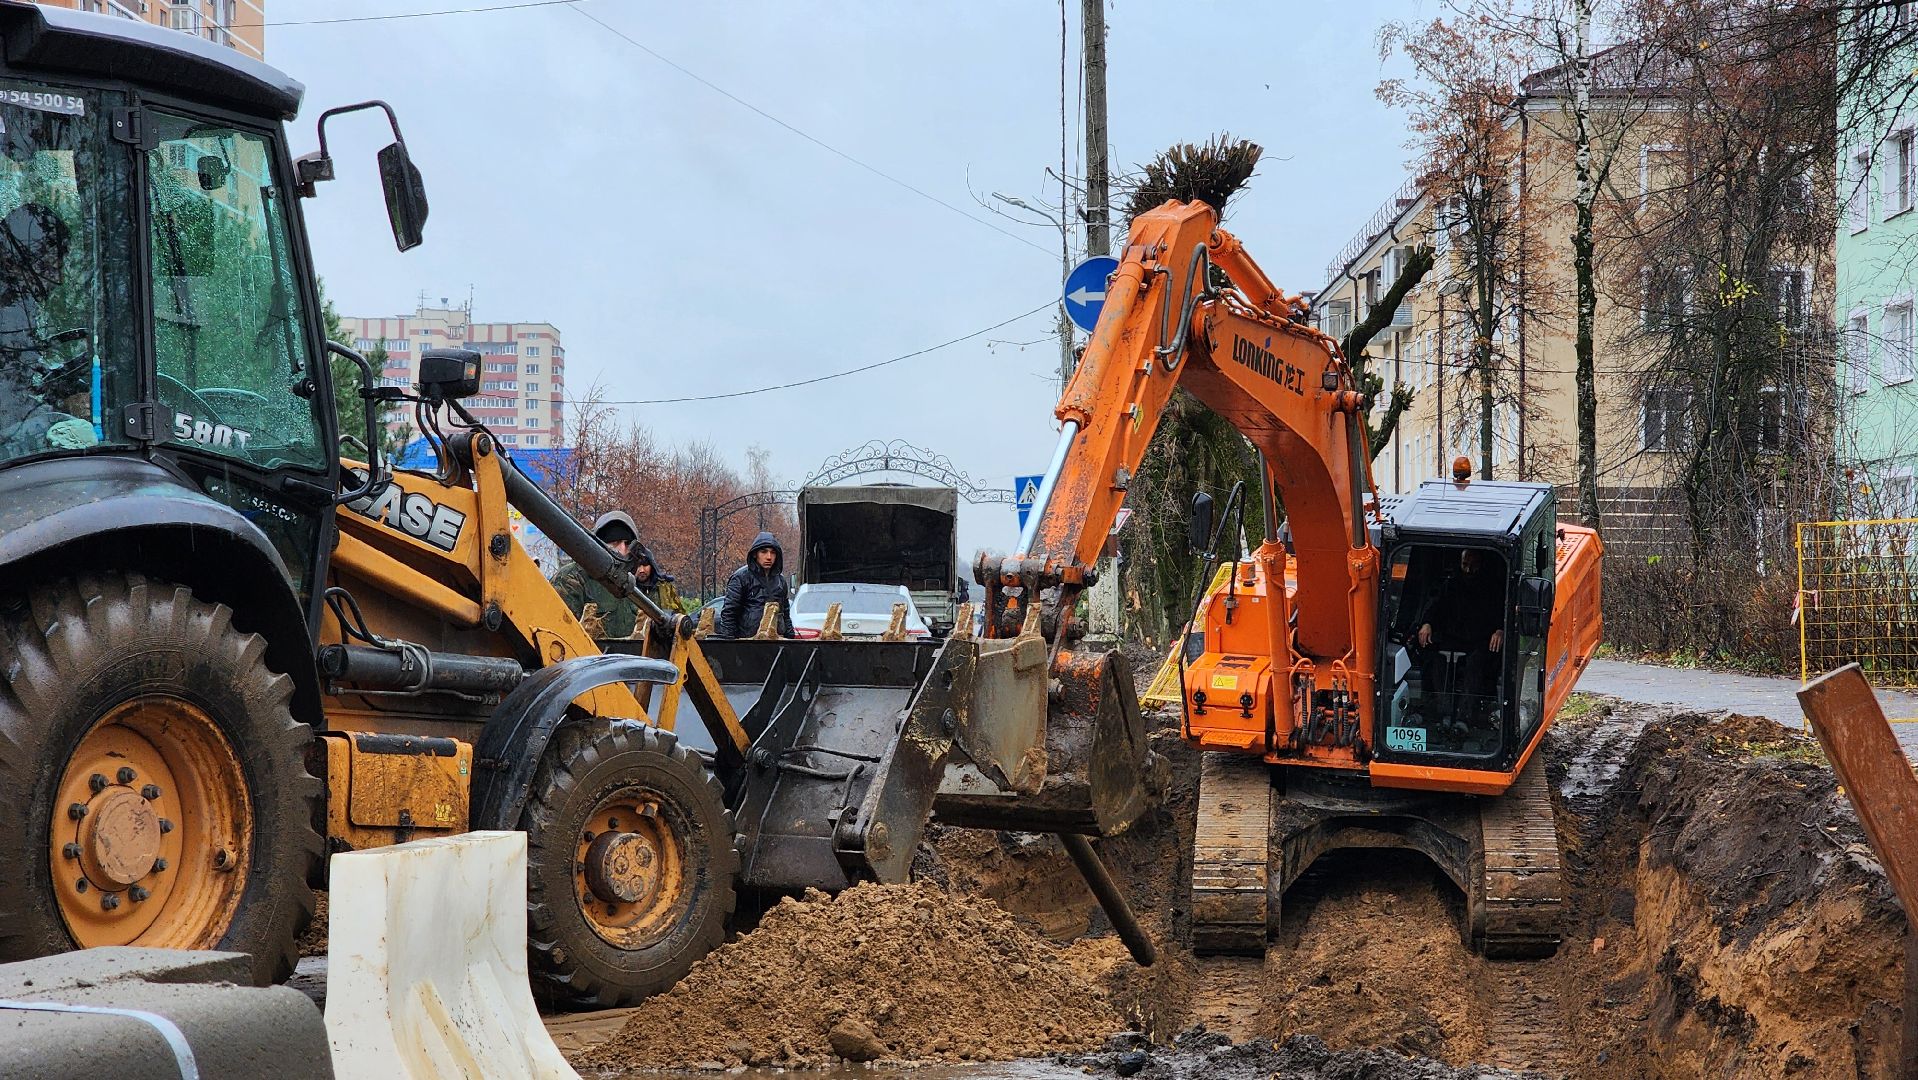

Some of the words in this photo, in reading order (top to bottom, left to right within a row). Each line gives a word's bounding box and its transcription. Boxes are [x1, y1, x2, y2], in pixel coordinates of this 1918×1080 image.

[10, 90, 30, 104] 54
[34, 92, 63, 107] 500
[66, 96, 84, 110] 54
[174, 412, 252, 450] 580T
[1392, 728, 1421, 741] 1096
